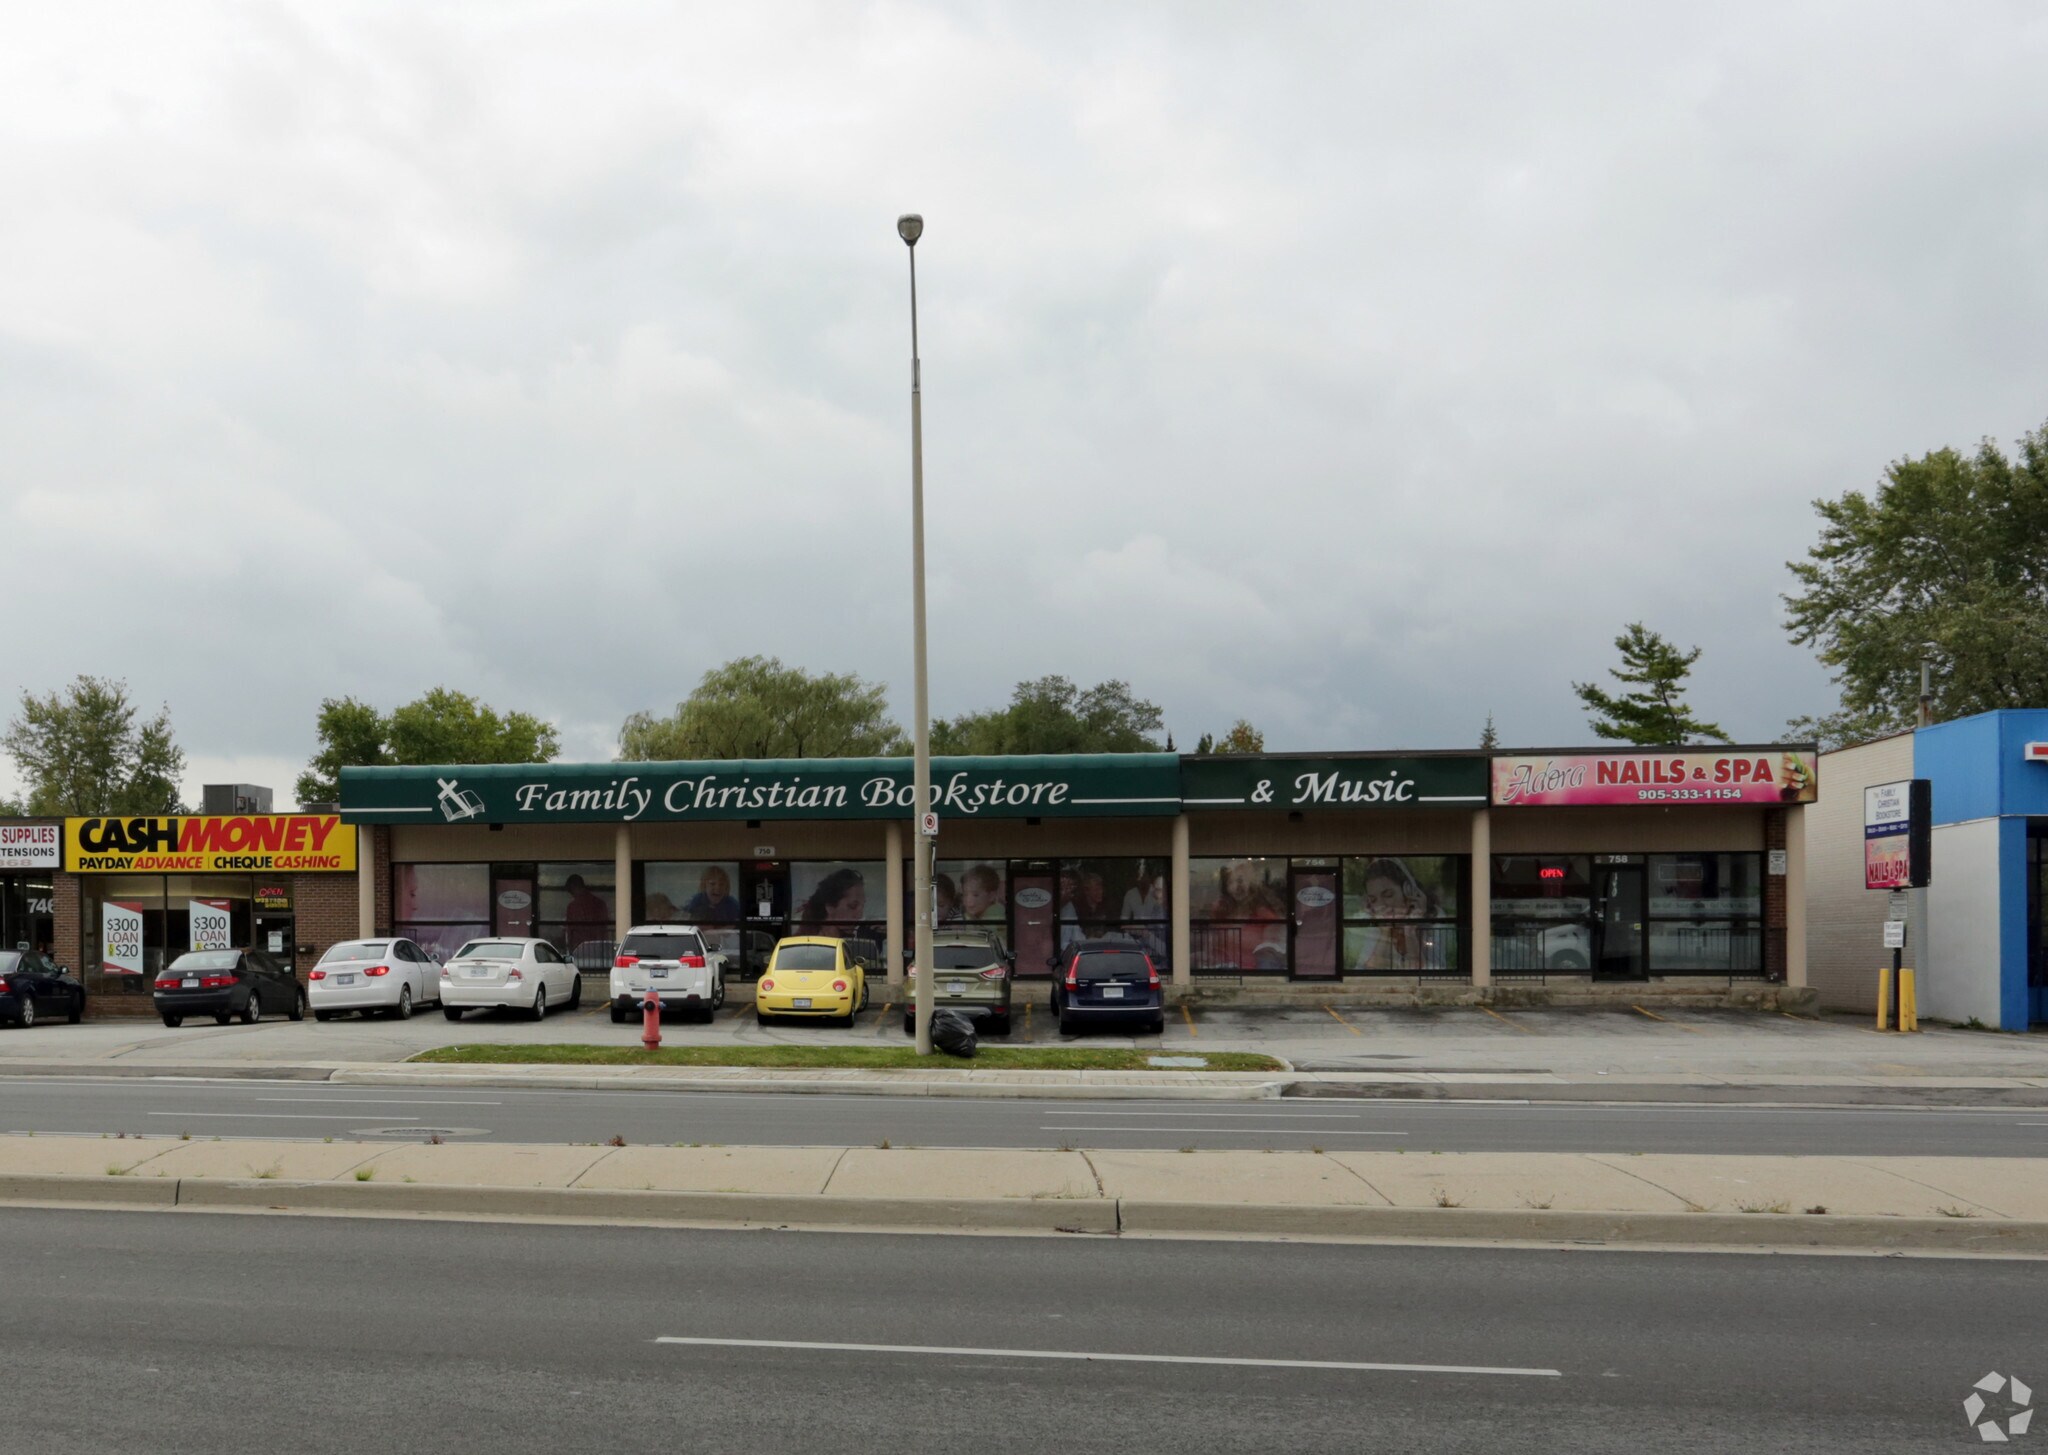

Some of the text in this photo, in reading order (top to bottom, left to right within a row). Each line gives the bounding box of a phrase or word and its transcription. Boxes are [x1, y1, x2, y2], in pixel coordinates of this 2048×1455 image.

[1251, 770, 1415, 803] & Music
[1503, 759, 1774, 801] Adora NAILS & SPA
[515, 777, 651, 820] Family
[664, 775, 848, 812] Christian
[1638, 789, 1741, 800] 905-333-1154
[2, 828, 55, 843] SUPPLIES
[0, 847, 55, 857] TENSIONS
[79, 855, 341, 870] PAYDAY ADVANCE CHEQUE CASHING
[1608, 854, 1628, 864] 758
[1540, 868, 1564, 878] OPEN
[1869, 862, 1889, 882] NAILS
[1894, 860, 1908, 880] SPA
[107, 918, 139, 931] $300
[194, 916, 226, 930] $300
[107, 932, 138, 943] LOAN
[195, 931, 226, 942] LOAN
[116, 944, 138, 957] $20
